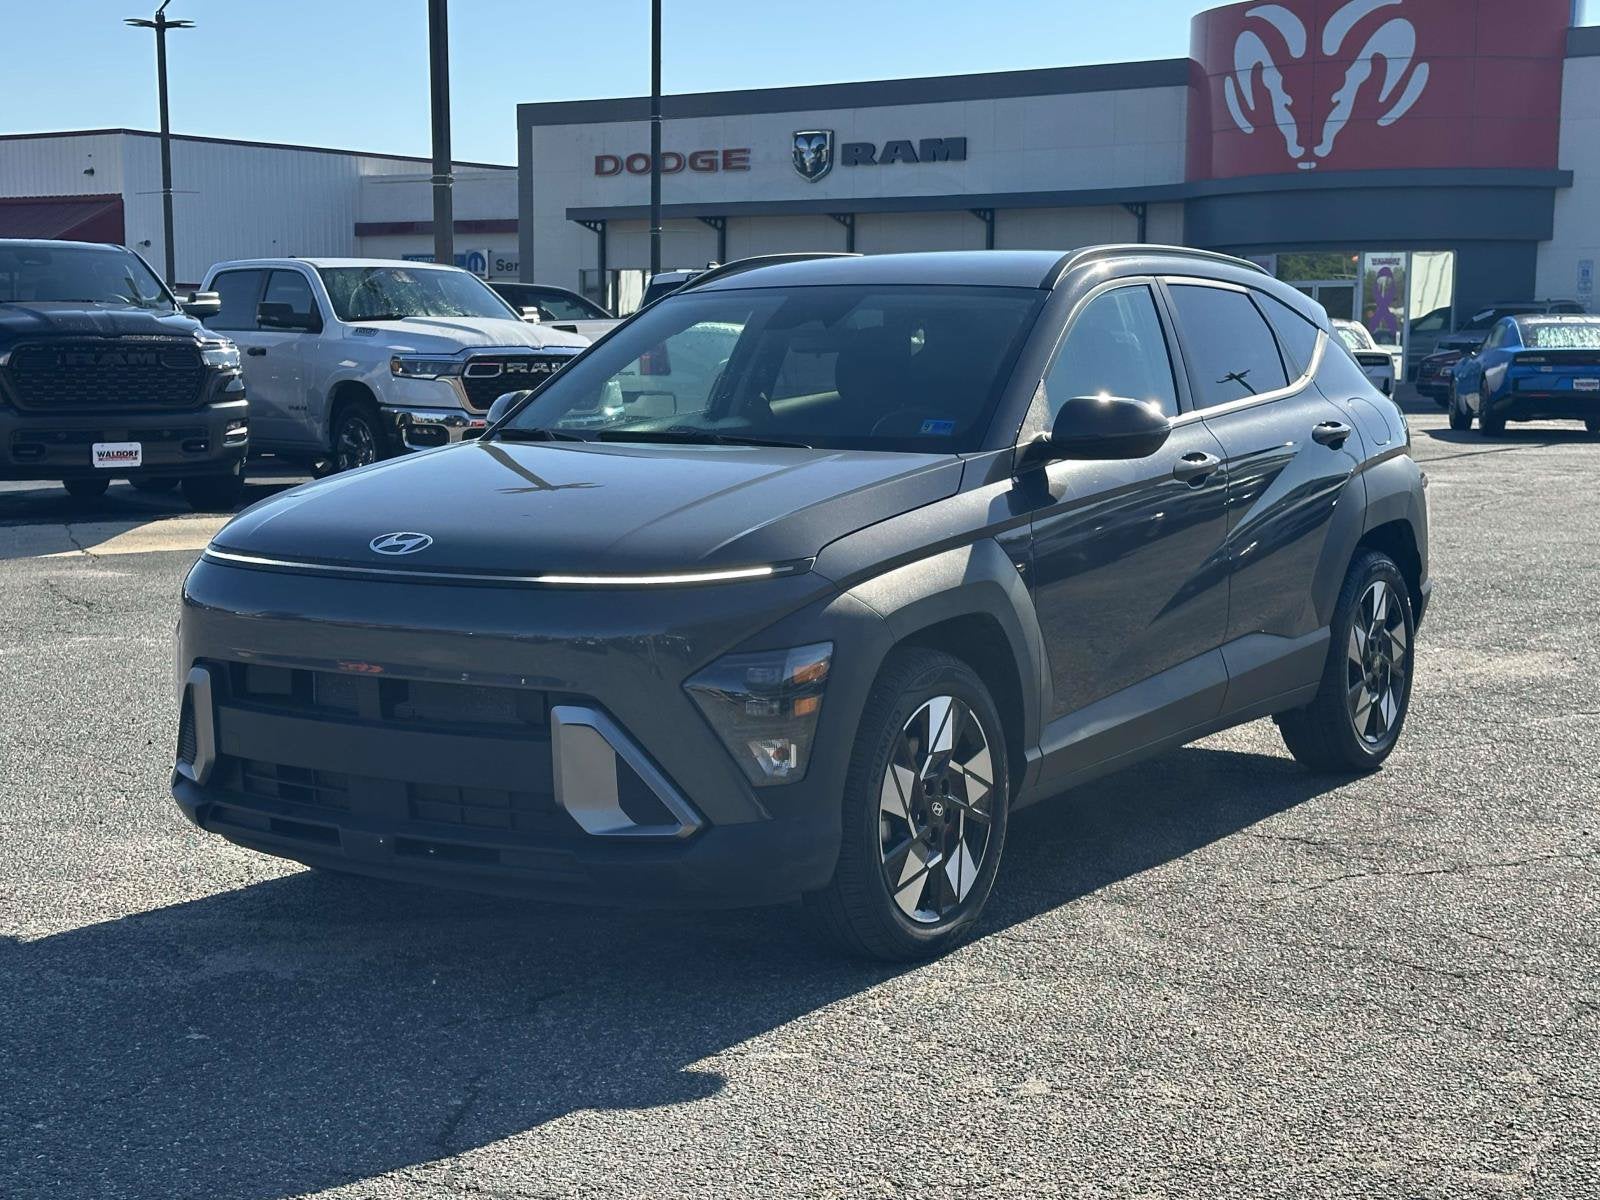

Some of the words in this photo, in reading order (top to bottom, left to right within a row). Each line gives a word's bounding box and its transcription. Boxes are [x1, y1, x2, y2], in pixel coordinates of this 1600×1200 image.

[595, 148, 751, 176] DODGE
[841, 137, 967, 166] RAM
[97, 450, 139, 458] WALDORF
